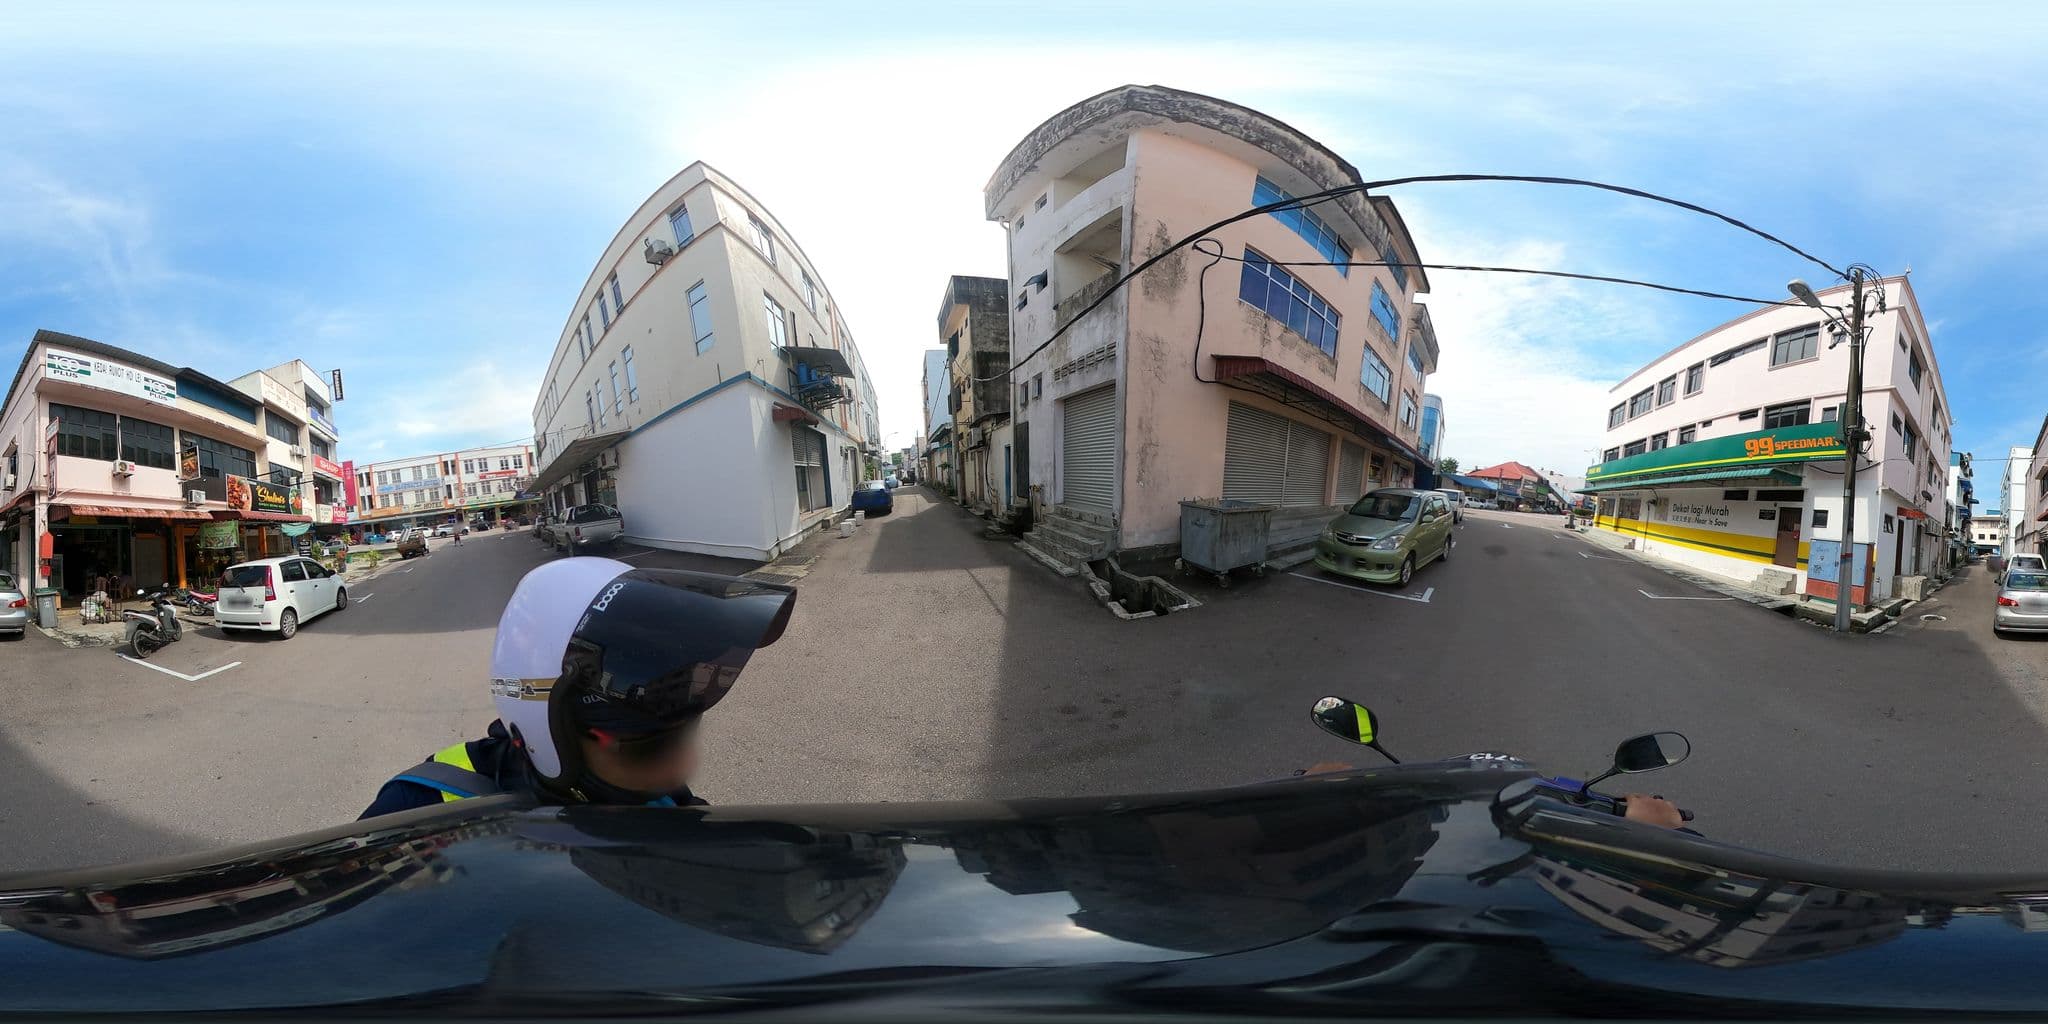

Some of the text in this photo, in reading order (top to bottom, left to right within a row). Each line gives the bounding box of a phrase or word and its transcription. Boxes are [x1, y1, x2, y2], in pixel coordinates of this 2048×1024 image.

[54, 356, 78, 371] 100
[53, 369, 78, 379] PLUS
[149, 379, 168, 396] 100
[149, 391, 168, 401] PLUS
[1745, 436, 1775, 458] 99
[320, 460, 339, 474] SHARP
[1672, 503, 1729, 517] Dekat lagi Murah
[1695, 516, 1707, 525] Near
[1714, 518, 1728, 527] Save
